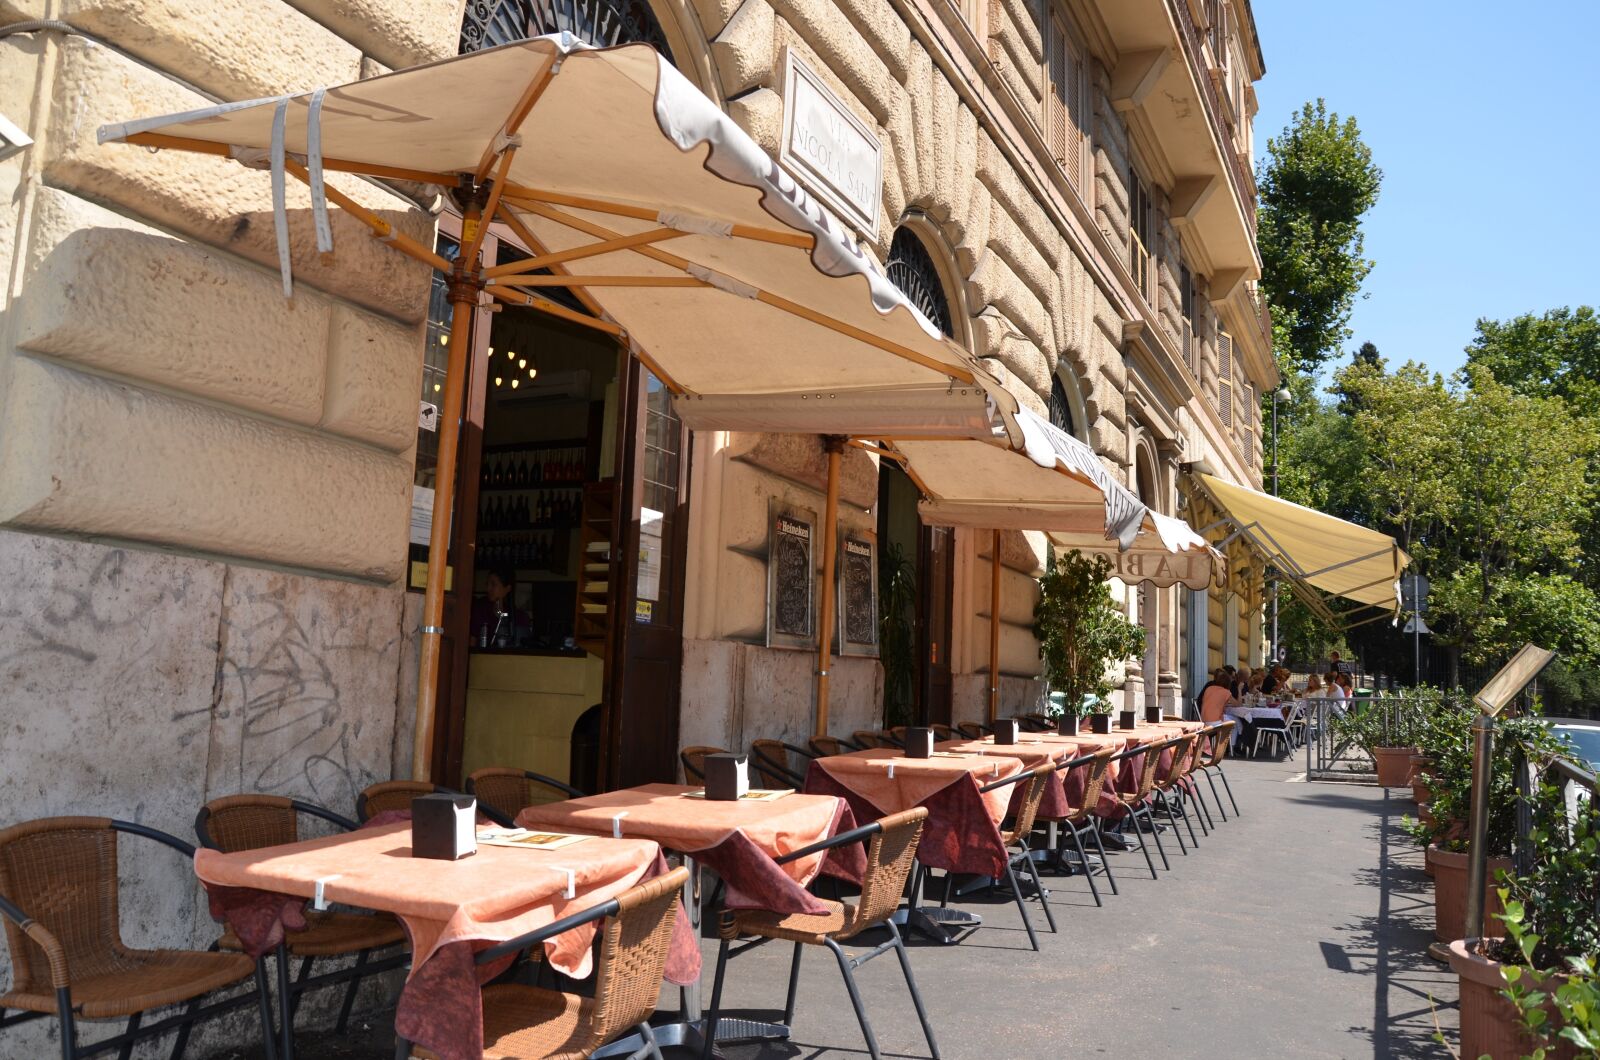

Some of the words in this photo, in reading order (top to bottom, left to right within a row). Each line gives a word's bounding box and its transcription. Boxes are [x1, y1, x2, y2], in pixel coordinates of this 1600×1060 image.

[829, 112, 850, 152] VIA
[793, 121, 842, 181] NICOLA
[847, 170, 875, 210] SALVI
[783, 521, 809, 538] Heineken
[847, 541, 870, 557] Heineken
